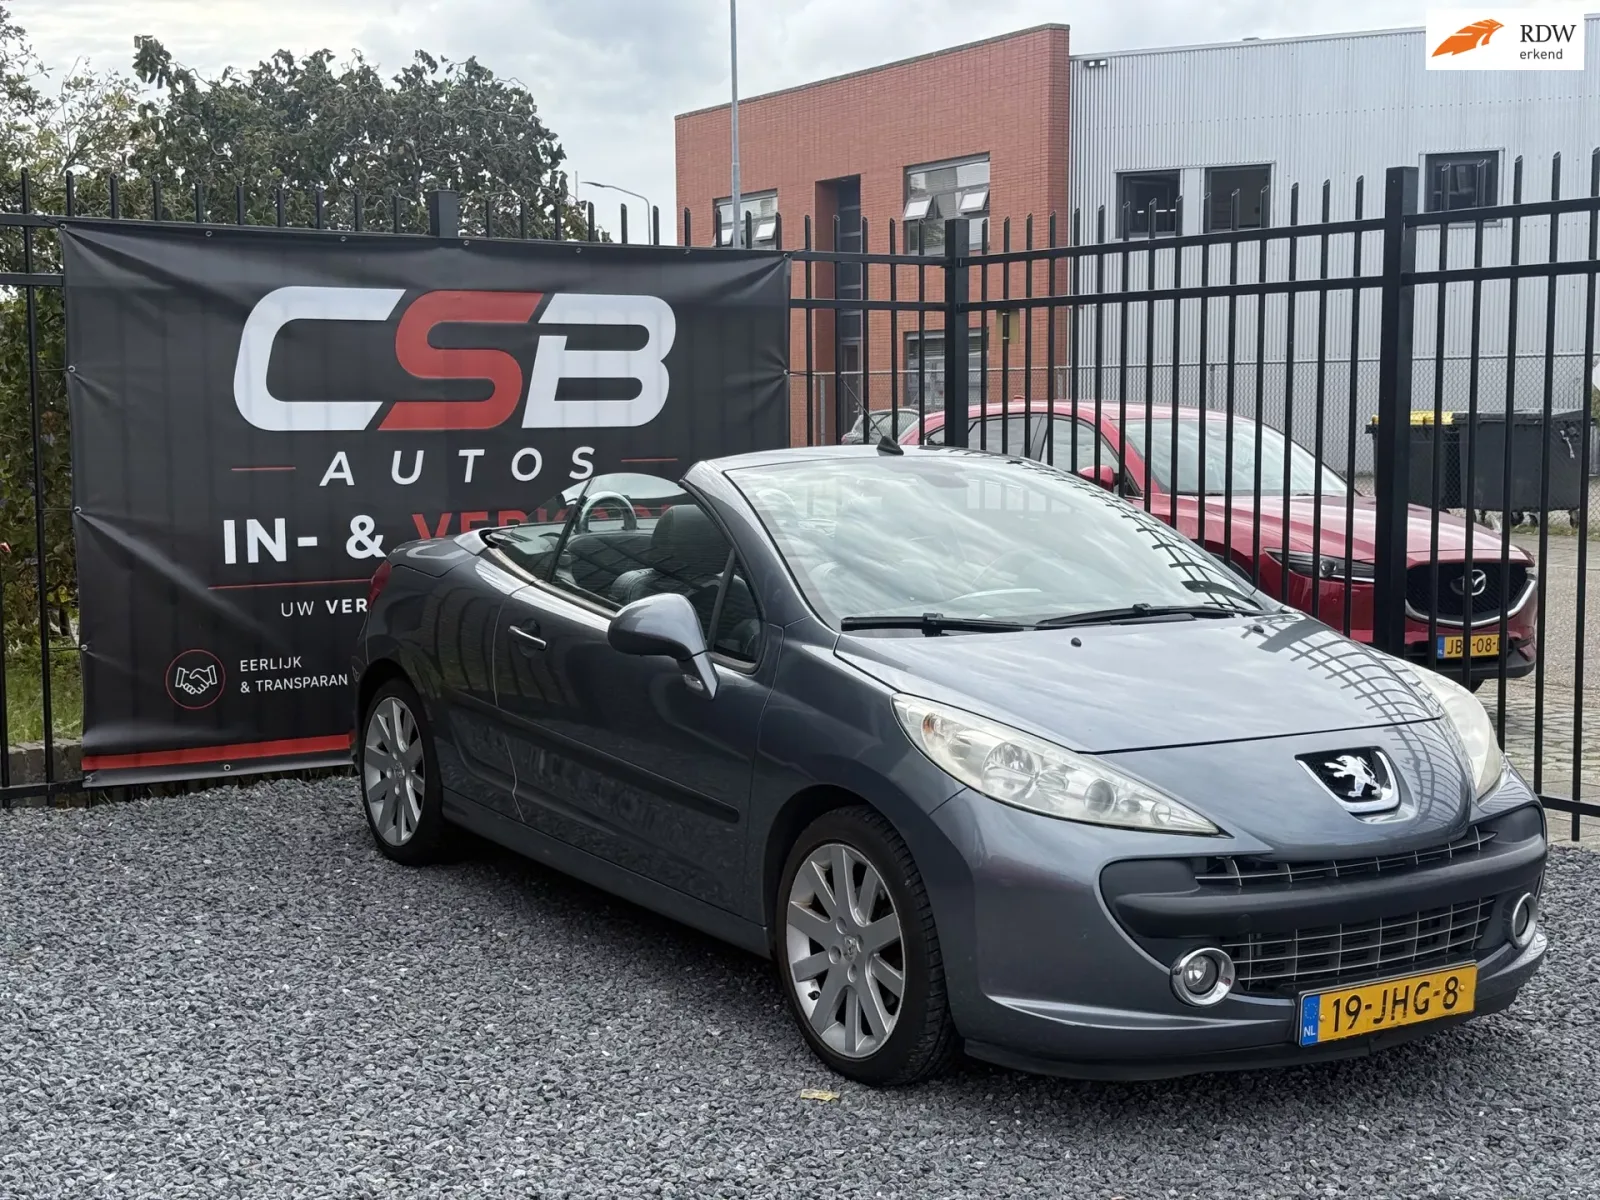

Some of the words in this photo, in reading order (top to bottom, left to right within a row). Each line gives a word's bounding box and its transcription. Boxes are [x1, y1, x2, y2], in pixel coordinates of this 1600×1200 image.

[233, 285, 677, 432] CSB
[319, 446, 596, 486] AUTOS
[223, 517, 318, 565] IN-
[345, 514, 387, 560] &
[281, 601, 314, 617] UW
[325, 598, 368, 614] VER
[240, 656, 302, 672] EERLIJK
[240, 681, 251, 693] &
[255, 673, 349, 692] TRANSPARAN
[1331, 975, 1460, 1033] 19-JHG-8
[1303, 1025, 1316, 1038] NL
